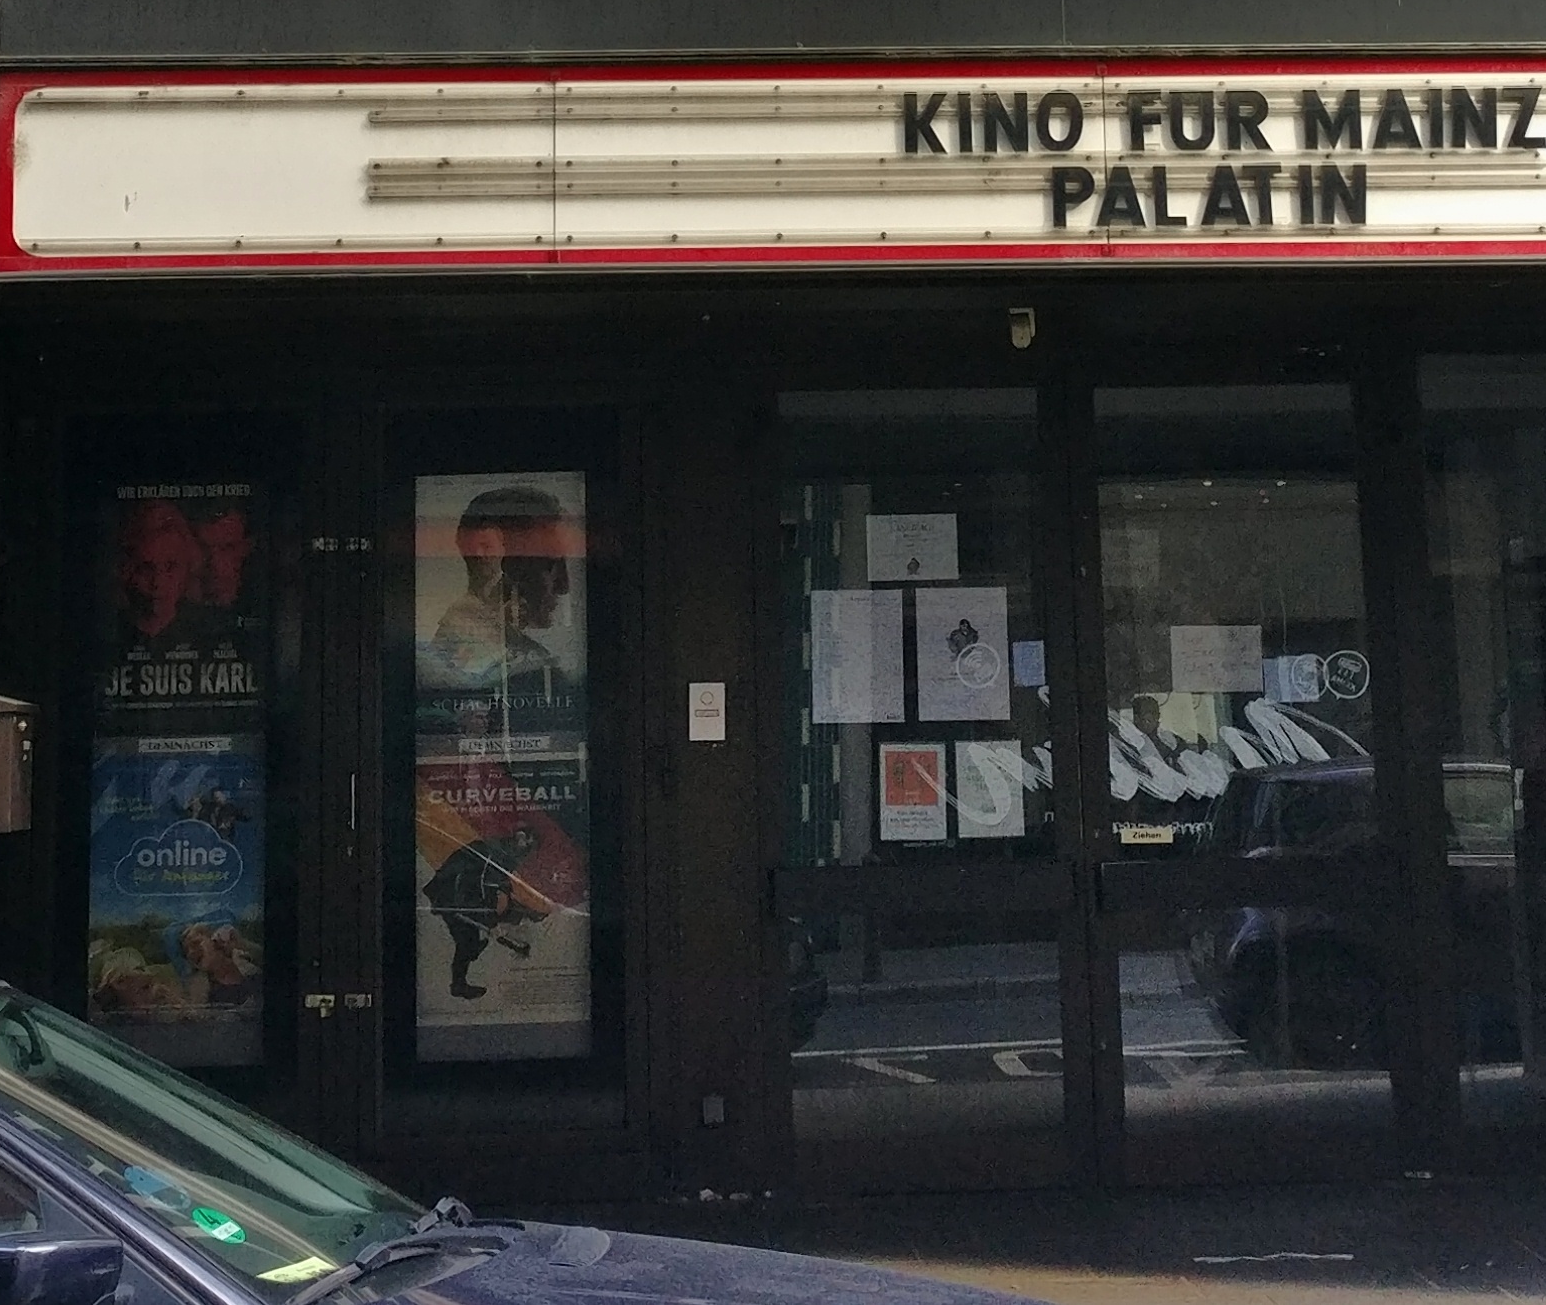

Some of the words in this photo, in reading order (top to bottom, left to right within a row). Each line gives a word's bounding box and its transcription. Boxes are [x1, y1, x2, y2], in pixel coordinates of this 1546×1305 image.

[903, 89, 1084, 155] KINO
[1302, 85, 1546, 152] MAINZ
[1052, 162, 1367, 229] PALATIN
[105, 663, 134, 696] JE
[139, 663, 193, 696] SUIS
[428, 785, 577, 805] CURVEBALL
[137, 839, 227, 867] online
